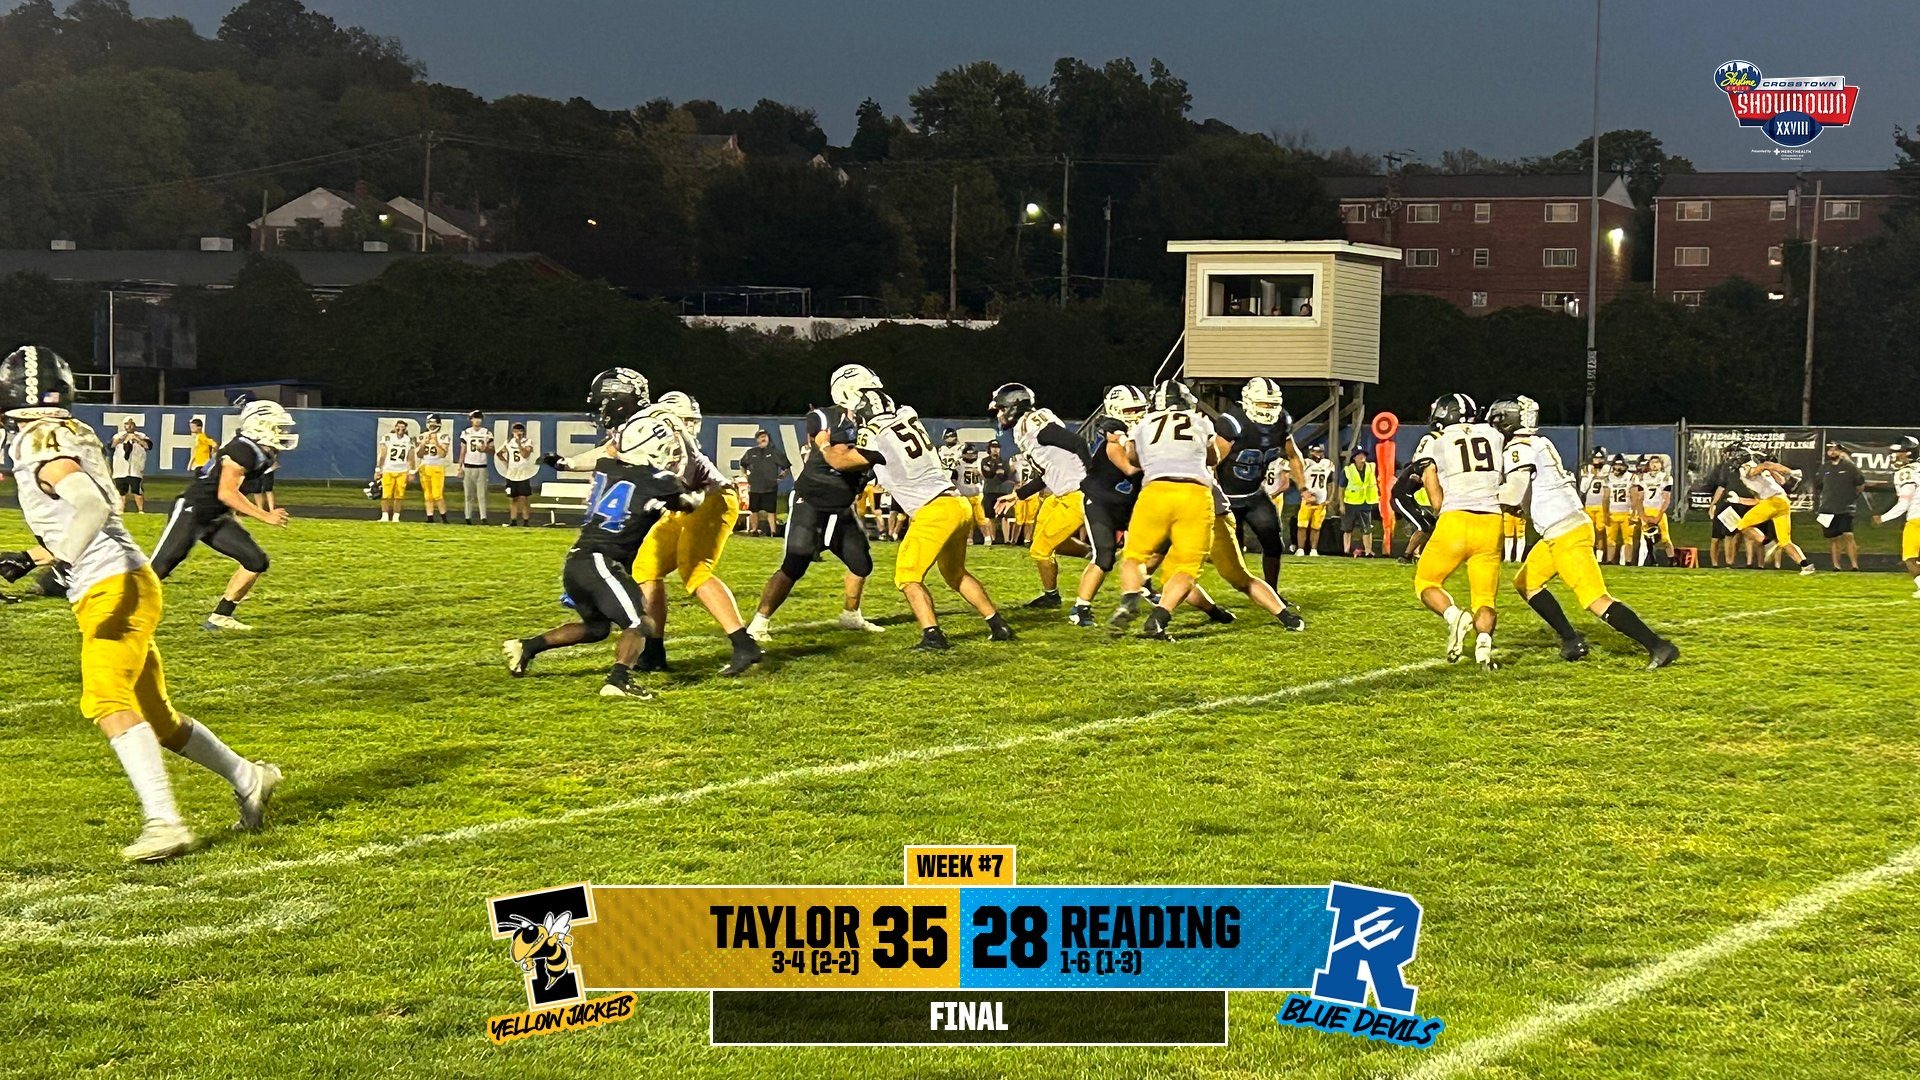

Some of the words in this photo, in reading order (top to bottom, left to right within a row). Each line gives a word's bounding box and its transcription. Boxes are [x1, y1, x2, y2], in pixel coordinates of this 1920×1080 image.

[1150, 414, 1193, 444] 72
[1693, 433, 1742, 441] NATIONAL
[394, 448, 413, 472] 24
[1454, 437, 1495, 473] 19
[1612, 488, 1627, 503] 12
[1648, 488, 1657, 500] 7
